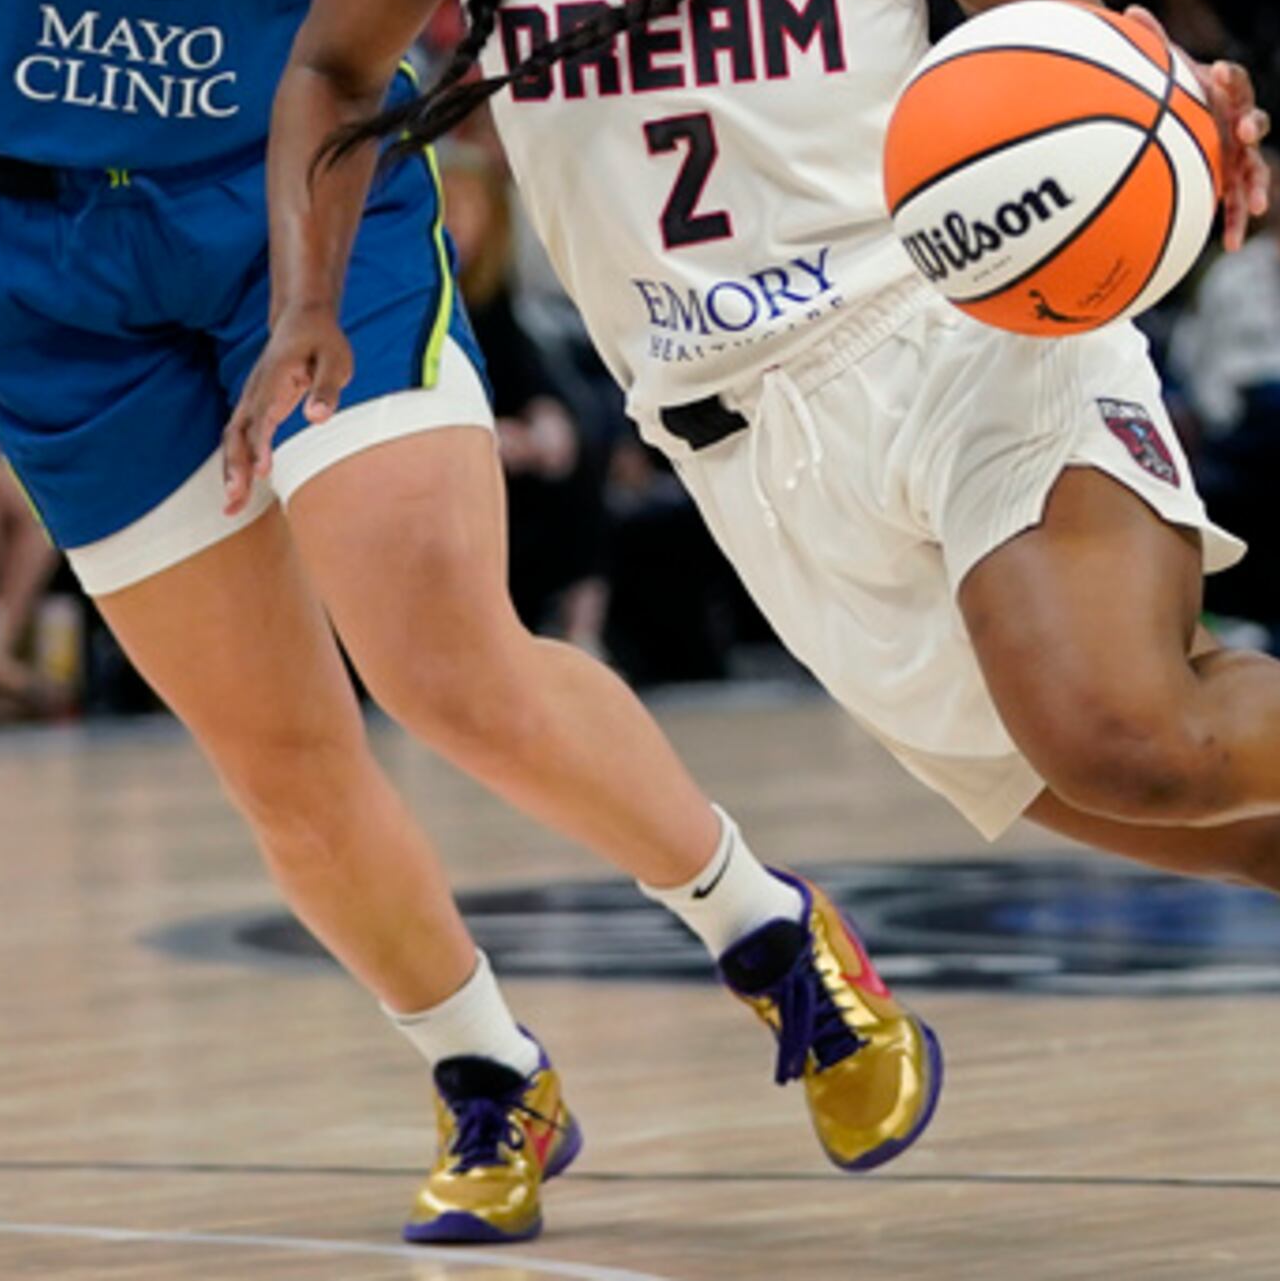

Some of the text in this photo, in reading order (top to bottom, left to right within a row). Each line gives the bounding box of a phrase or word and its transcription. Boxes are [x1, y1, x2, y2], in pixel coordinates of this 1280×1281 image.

[36, 3, 224, 71] MAYO
[13, 54, 240, 118] CLINIC
[642, 110, 734, 251] 2
[900, 177, 1075, 283] Wilson
[631, 245, 835, 336] EMORY
